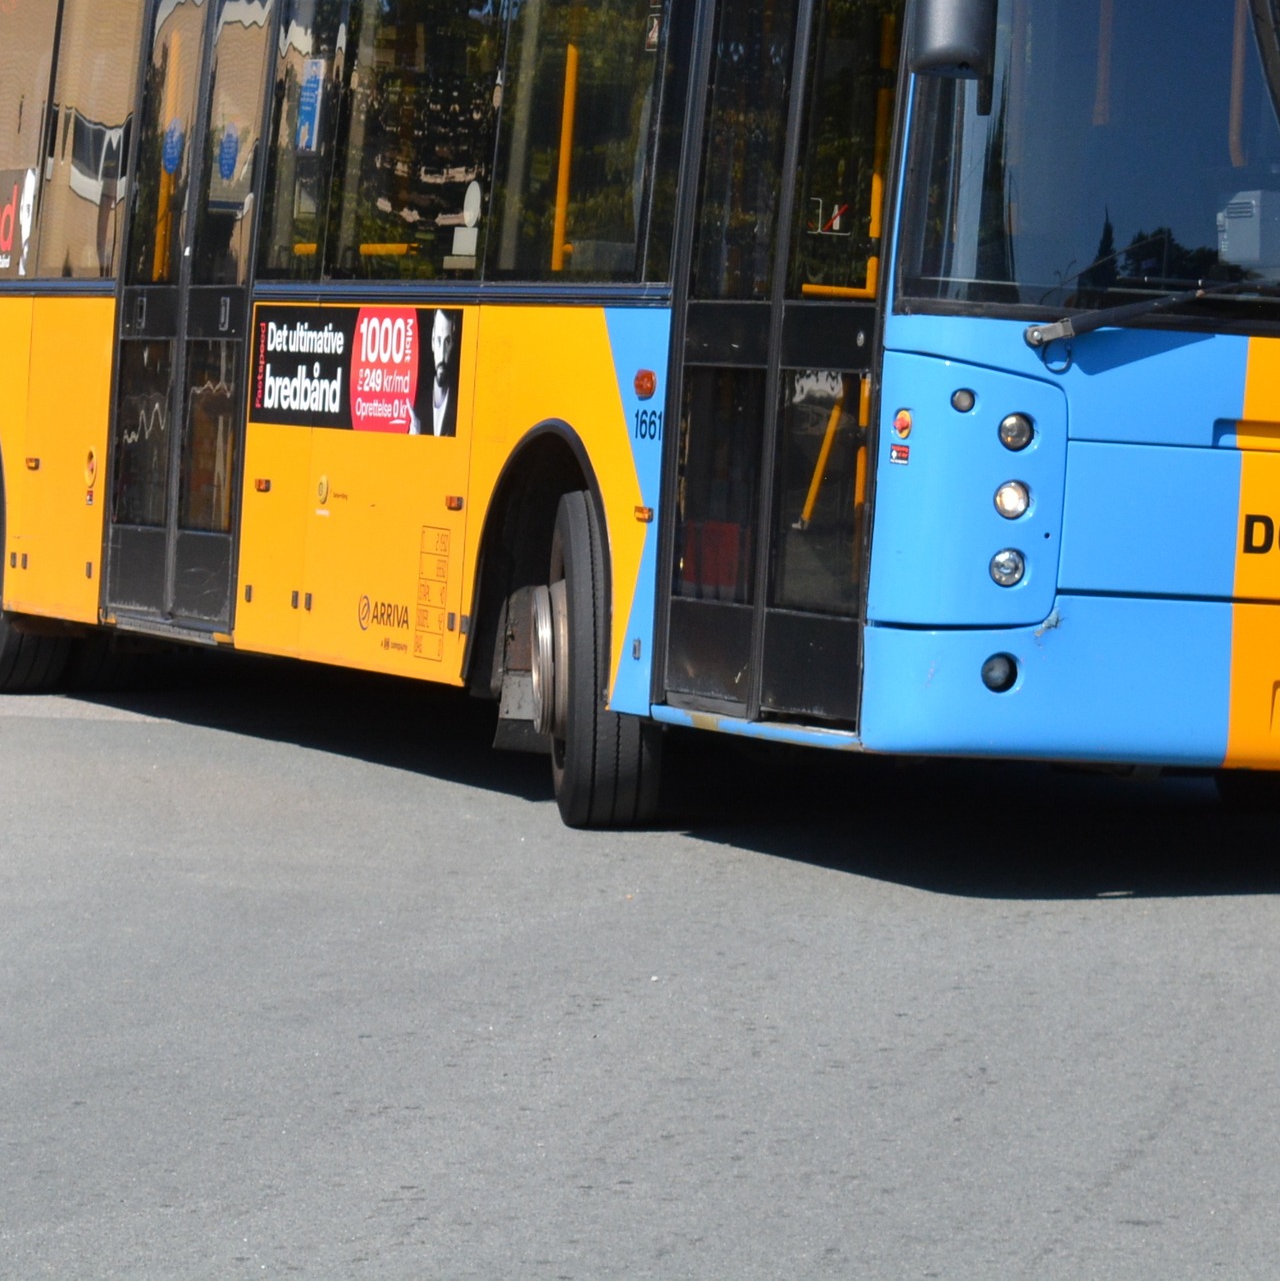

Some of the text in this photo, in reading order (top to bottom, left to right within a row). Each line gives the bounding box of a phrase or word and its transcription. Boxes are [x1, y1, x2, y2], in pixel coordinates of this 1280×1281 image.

[267, 321, 344, 355] Det ultimative
[360, 317, 405, 364] 1000
[405, 319, 414, 363] Mbit
[255, 322, 266, 408] Fastspeed
[363, 368, 410, 394] 249 kr/md
[264, 361, 342, 413] bredbånd
[355, 398, 408, 421] Oprettelse 0 kr
[634, 408, 663, 441] 1661
[371, 601, 409, 630] ARRIVA
